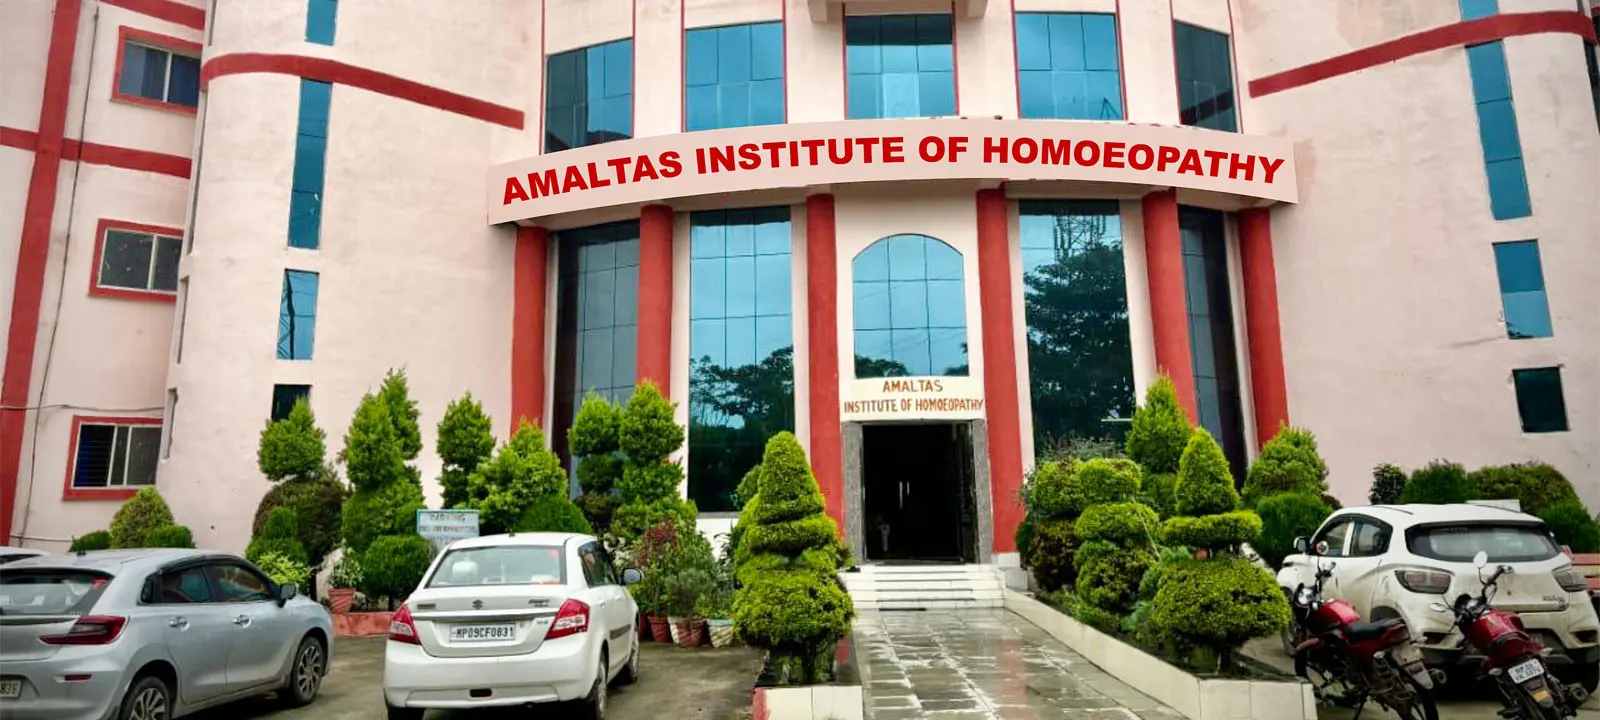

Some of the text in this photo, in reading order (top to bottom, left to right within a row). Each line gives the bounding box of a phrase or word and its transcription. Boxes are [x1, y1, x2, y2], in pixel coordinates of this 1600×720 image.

[503, 135, 1286, 206] AMALTAS INSTITUTE OF HOMOEOPATHY
[882, 379, 944, 393] AMALTAS
[844, 398, 984, 413] INSTITUTE OF HOMOEOPATHY
